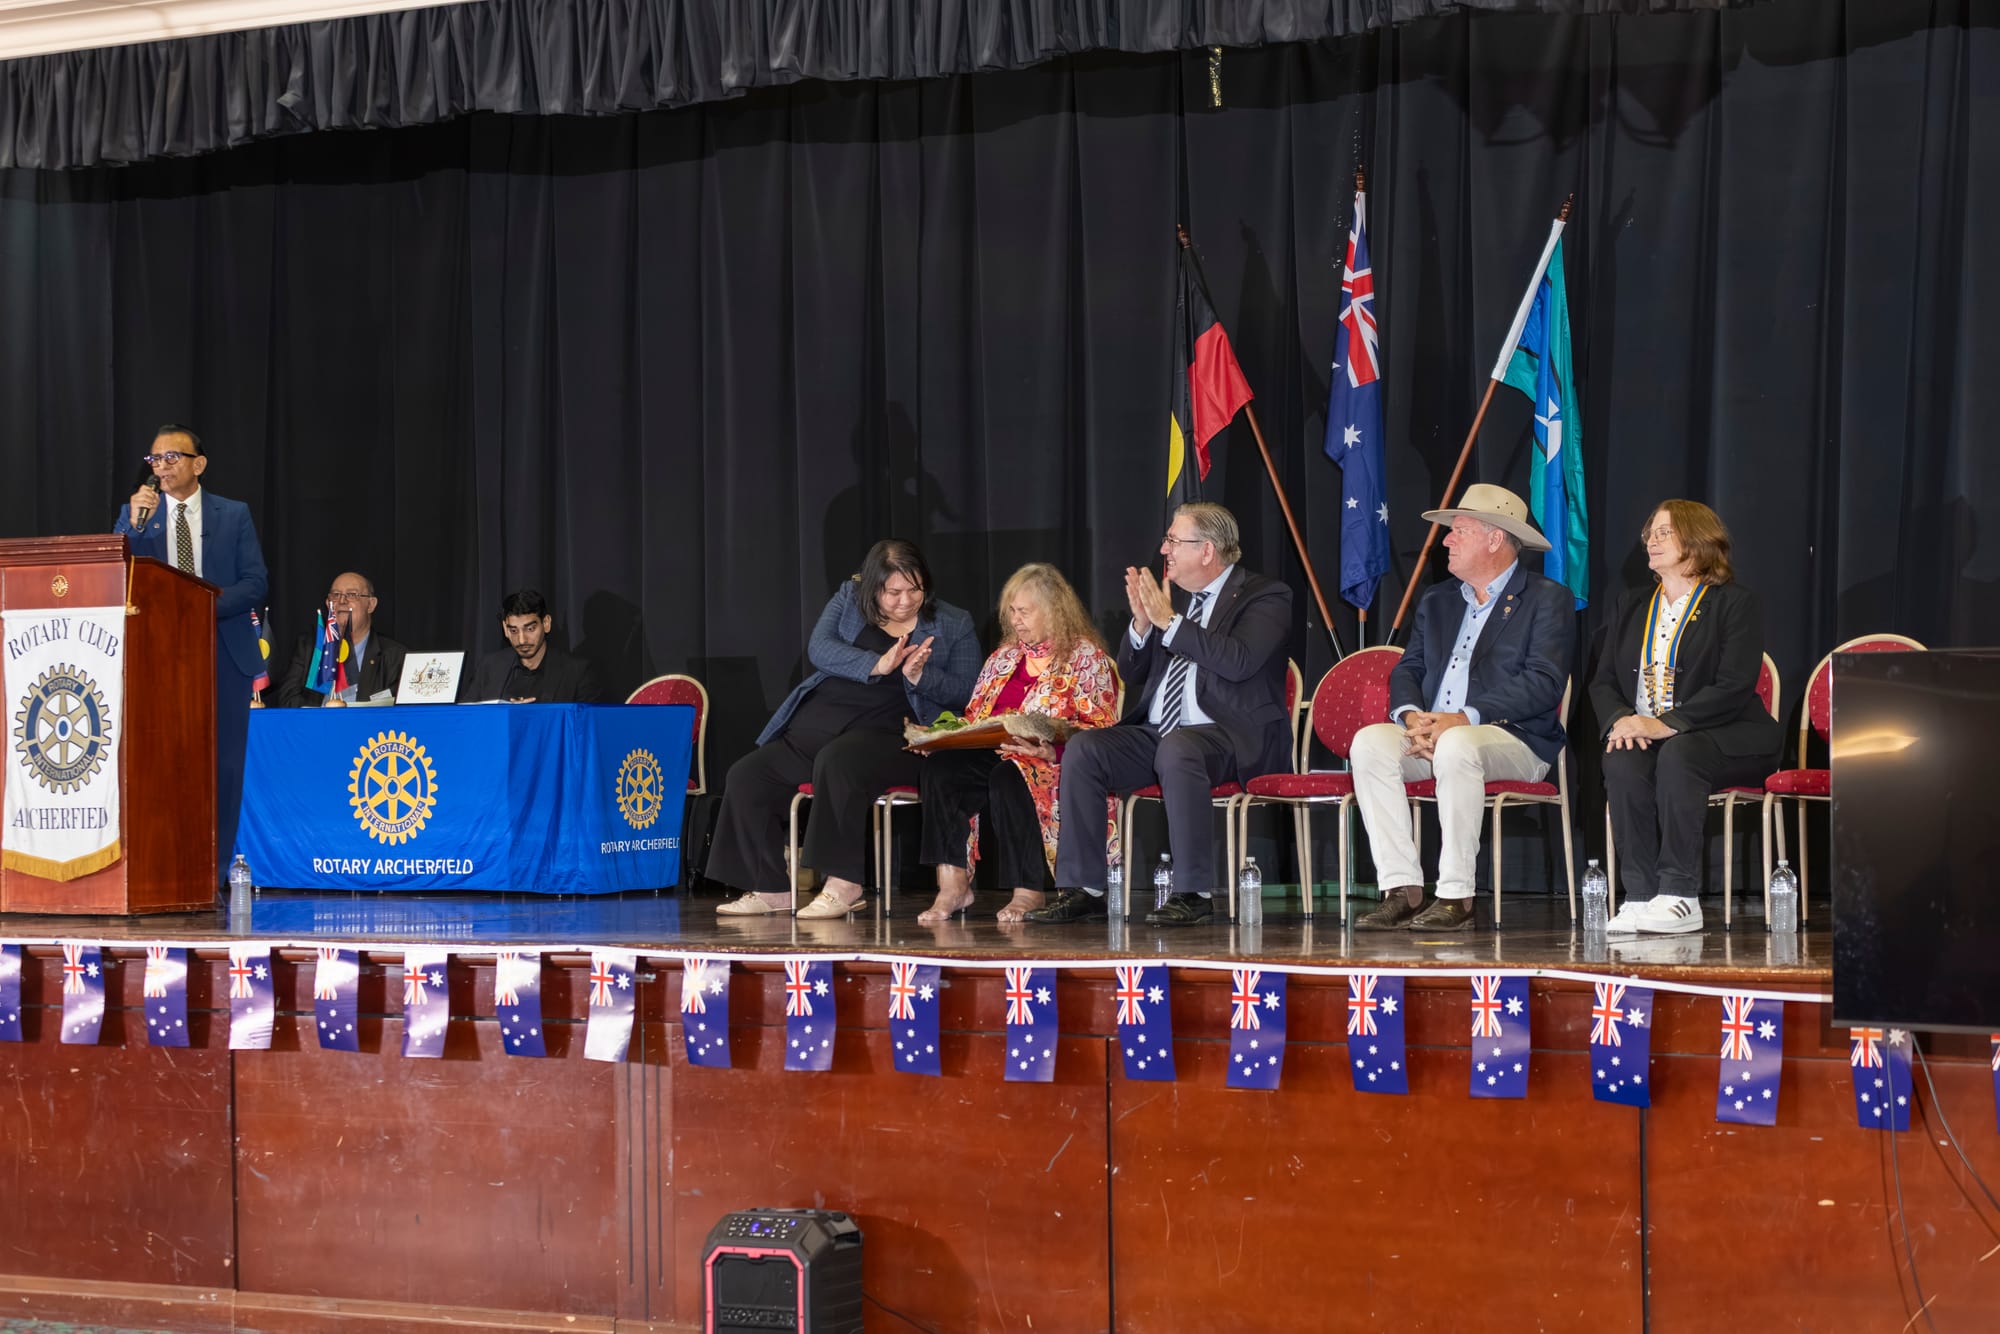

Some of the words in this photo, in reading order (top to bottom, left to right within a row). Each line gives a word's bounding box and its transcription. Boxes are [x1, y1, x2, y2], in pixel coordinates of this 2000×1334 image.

[8, 618, 71, 660] ROTARY
[79, 619, 119, 657] CLUB
[48, 678, 79, 693] ROTARY
[374, 743, 411, 757] ROTARY
[34, 752, 95, 780] INTERNATIONAL
[362, 804, 425, 833] INTERNATIONAL
[601, 840, 631, 854] ROTARY
[313, 858, 371, 874] ROTARY
[374, 858, 474, 875] ARCHERFIELD
